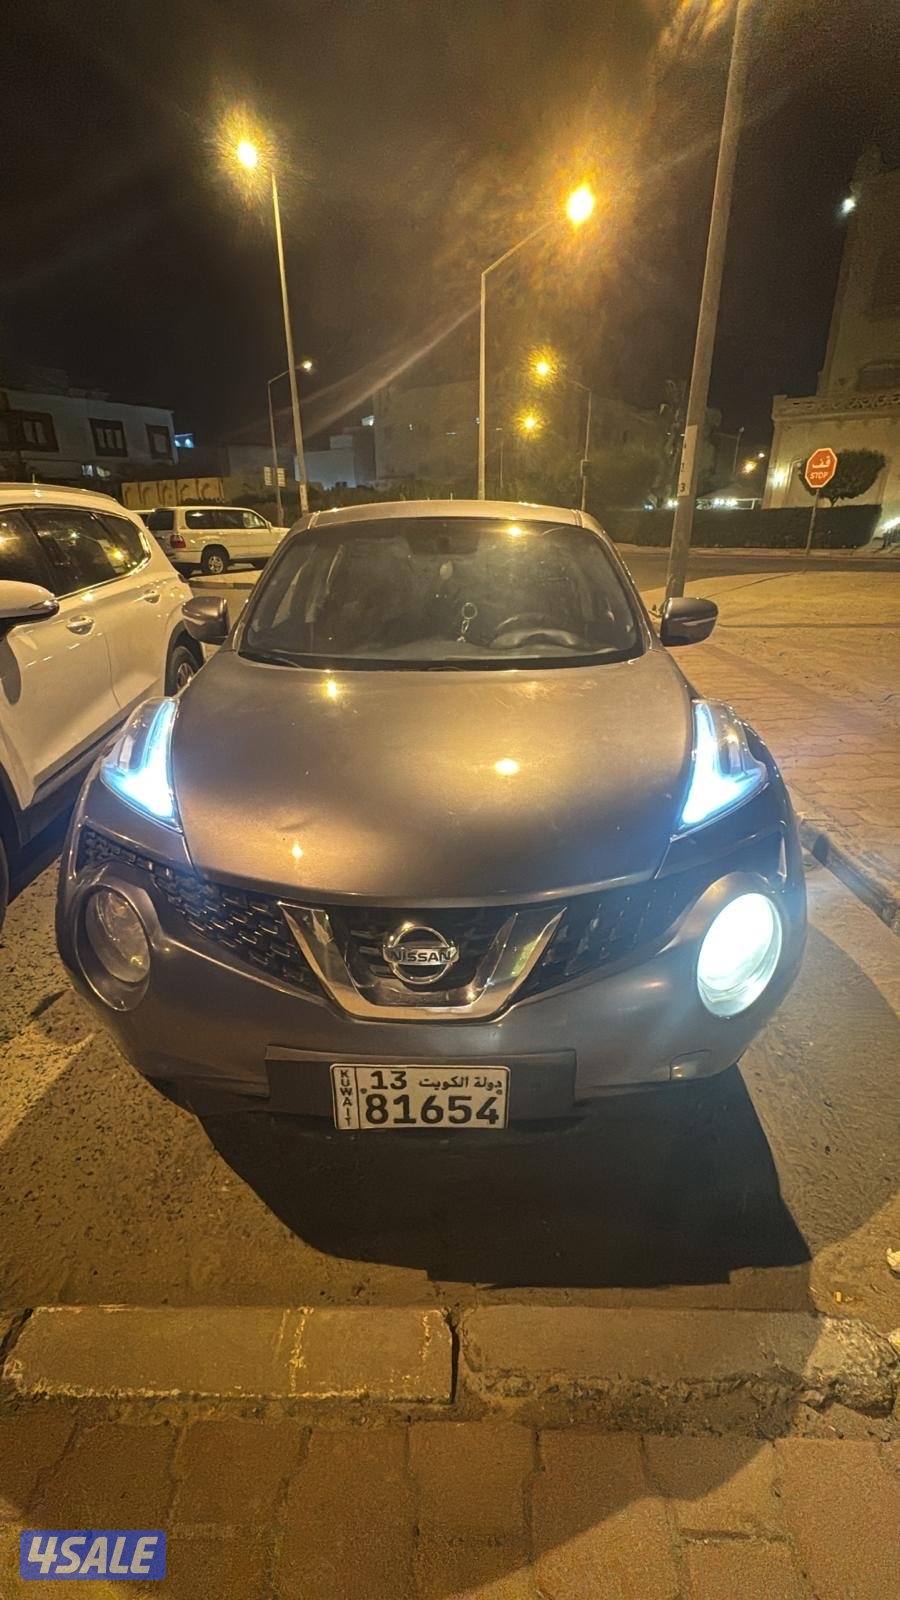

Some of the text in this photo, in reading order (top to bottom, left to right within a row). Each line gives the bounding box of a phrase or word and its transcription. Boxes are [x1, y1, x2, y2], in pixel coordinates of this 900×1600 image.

[812, 455, 831, 469] قف
[810, 471, 829, 480] STOP
[392, 950, 451, 962] NISSAN
[370, 1070, 408, 1090] 13
[418, 1076, 503, 1091] دولة الكويت
[340, 1069, 353, 1127] KUWAIT
[365, 1093, 500, 1125] 81654
